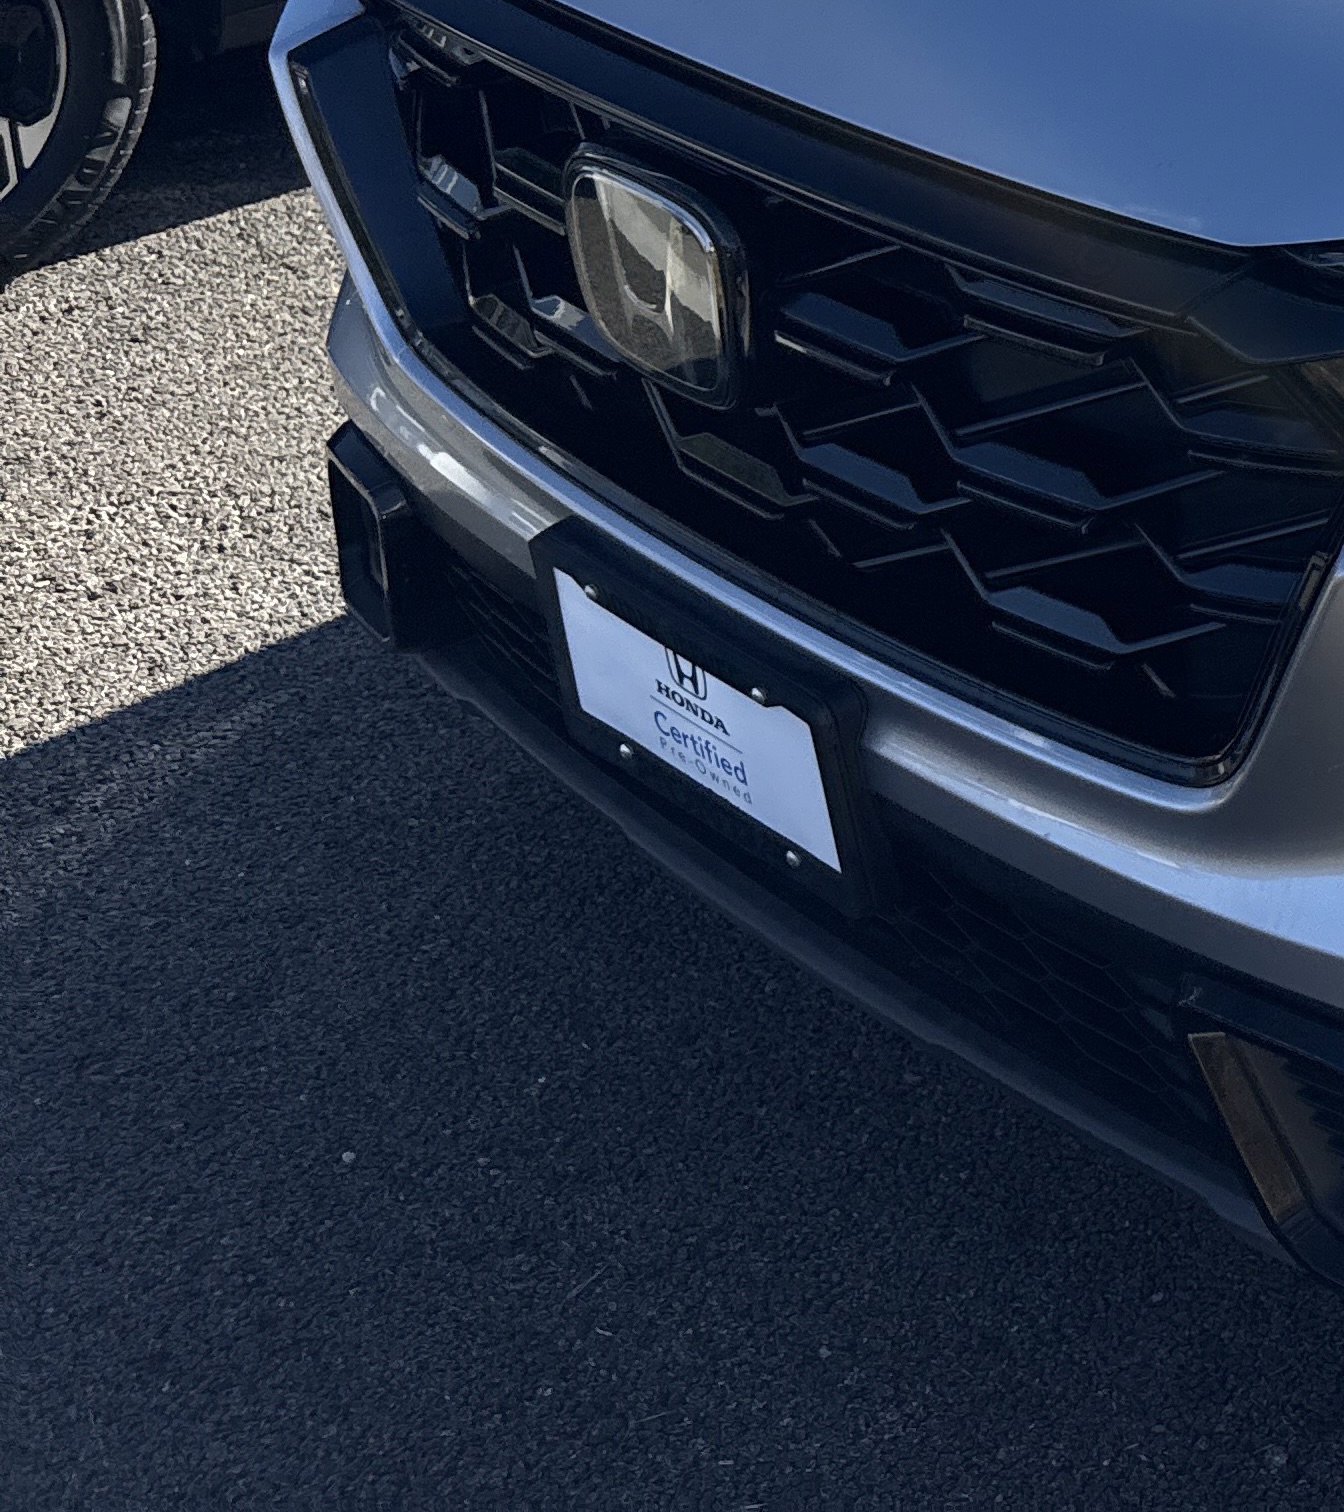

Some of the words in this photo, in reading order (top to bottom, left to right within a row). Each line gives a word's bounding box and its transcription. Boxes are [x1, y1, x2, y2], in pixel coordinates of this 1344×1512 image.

[655, 678, 731, 737] HONDA
[654, 710, 749, 787] Certified
[659, 736, 753, 805] Pre-Owned
